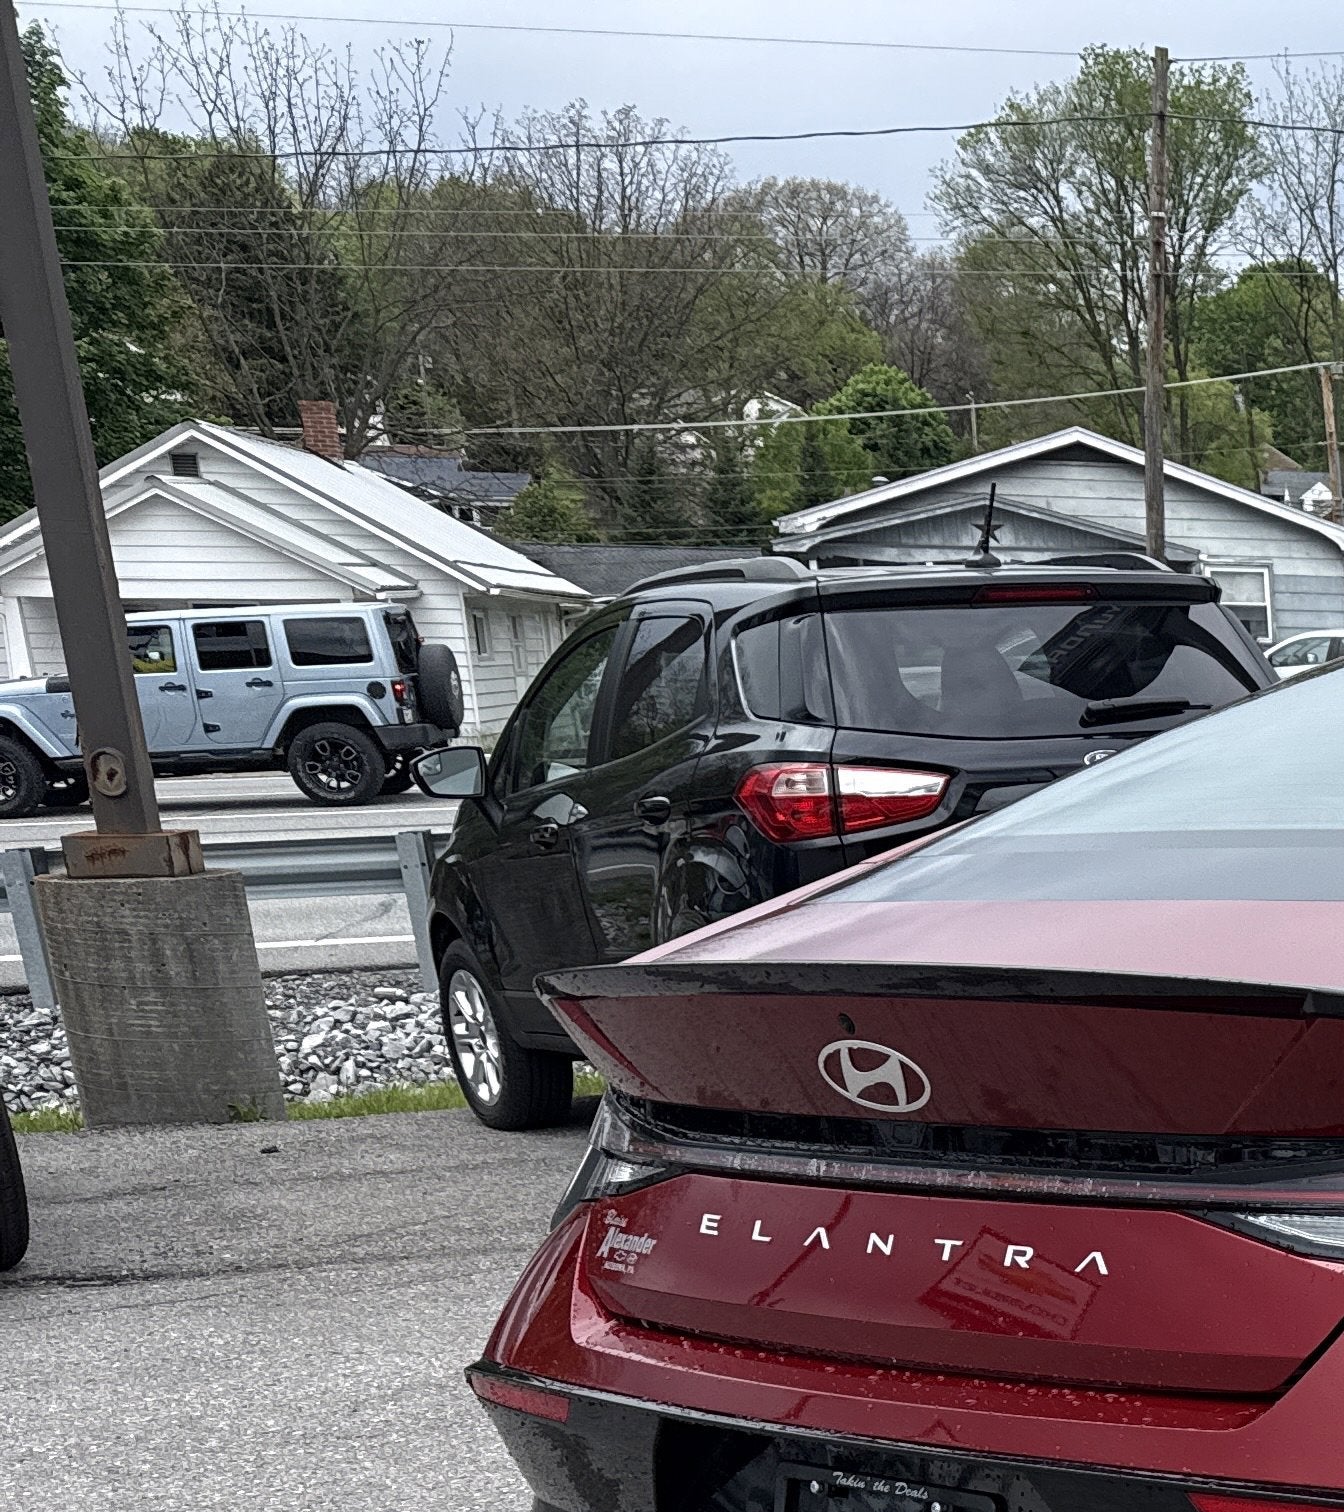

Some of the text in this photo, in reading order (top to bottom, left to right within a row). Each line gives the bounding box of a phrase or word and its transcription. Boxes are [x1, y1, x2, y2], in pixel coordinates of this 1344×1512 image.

[596, 1226, 657, 1258] Alexander
[700, 1213, 1109, 1275] ELANTRA
[873, 1480, 890, 1493] the
[895, 1481, 929, 1500] Deals
